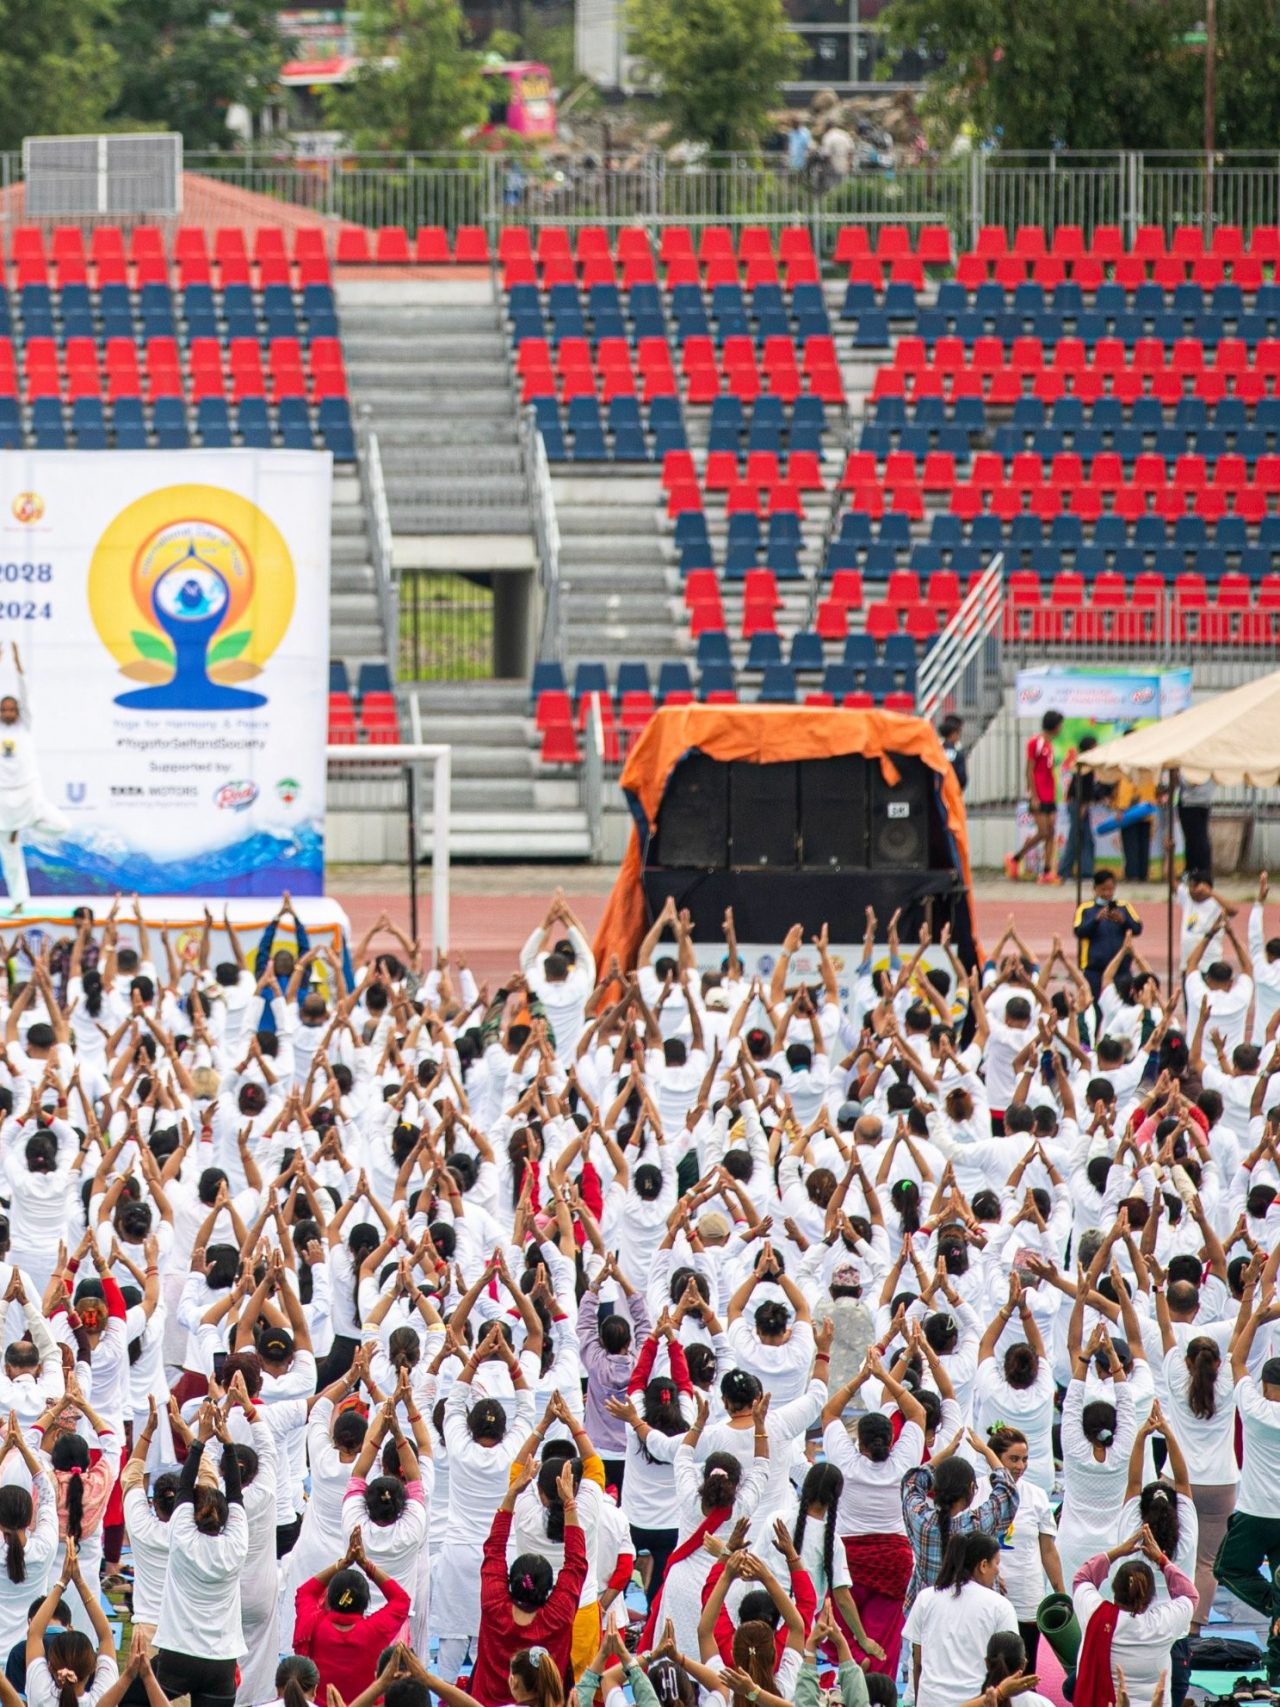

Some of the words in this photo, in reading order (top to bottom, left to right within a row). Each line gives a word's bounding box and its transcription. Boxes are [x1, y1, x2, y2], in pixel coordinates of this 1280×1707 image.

[149, 761, 211, 774] Supported
[109, 785, 145, 796] TATA
[148, 785, 199, 797] MOTORS
